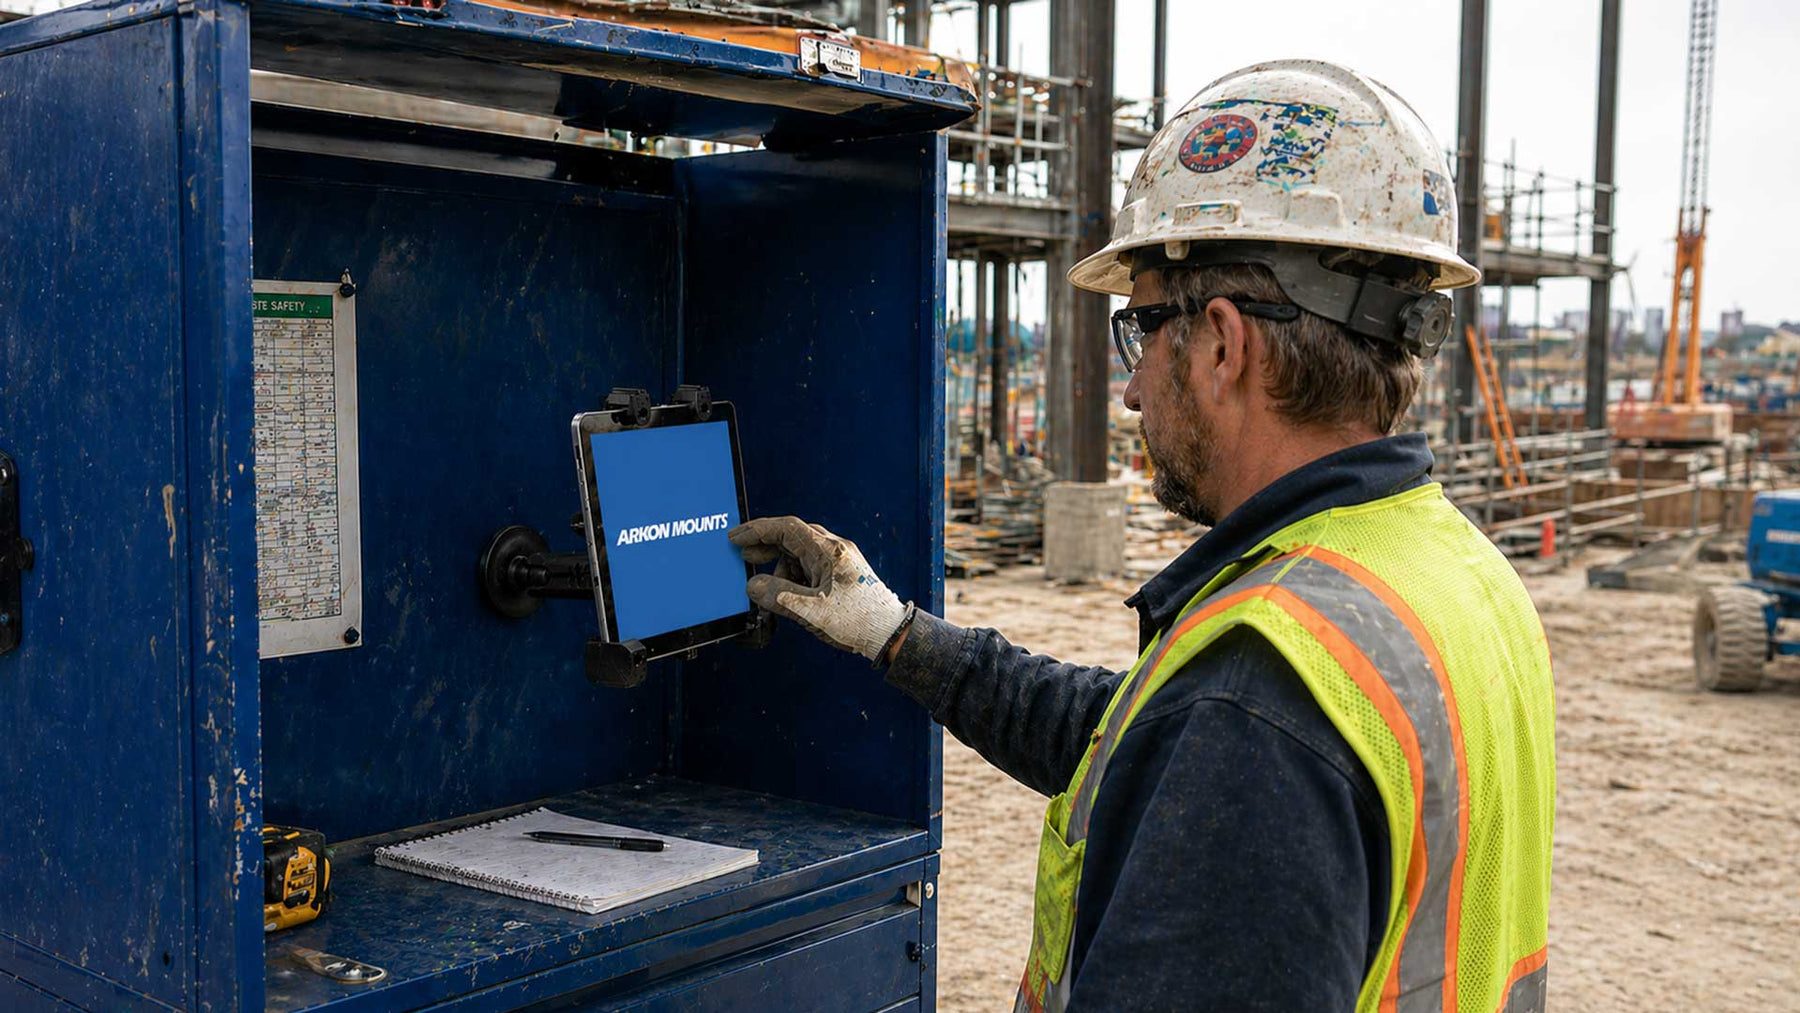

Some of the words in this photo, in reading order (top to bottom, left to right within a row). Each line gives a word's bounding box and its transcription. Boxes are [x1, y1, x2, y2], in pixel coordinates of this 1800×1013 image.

[270, 301, 305, 311] SAFETY
[616, 523, 671, 546] ARKON
[671, 513, 728, 537] MOUNTS
